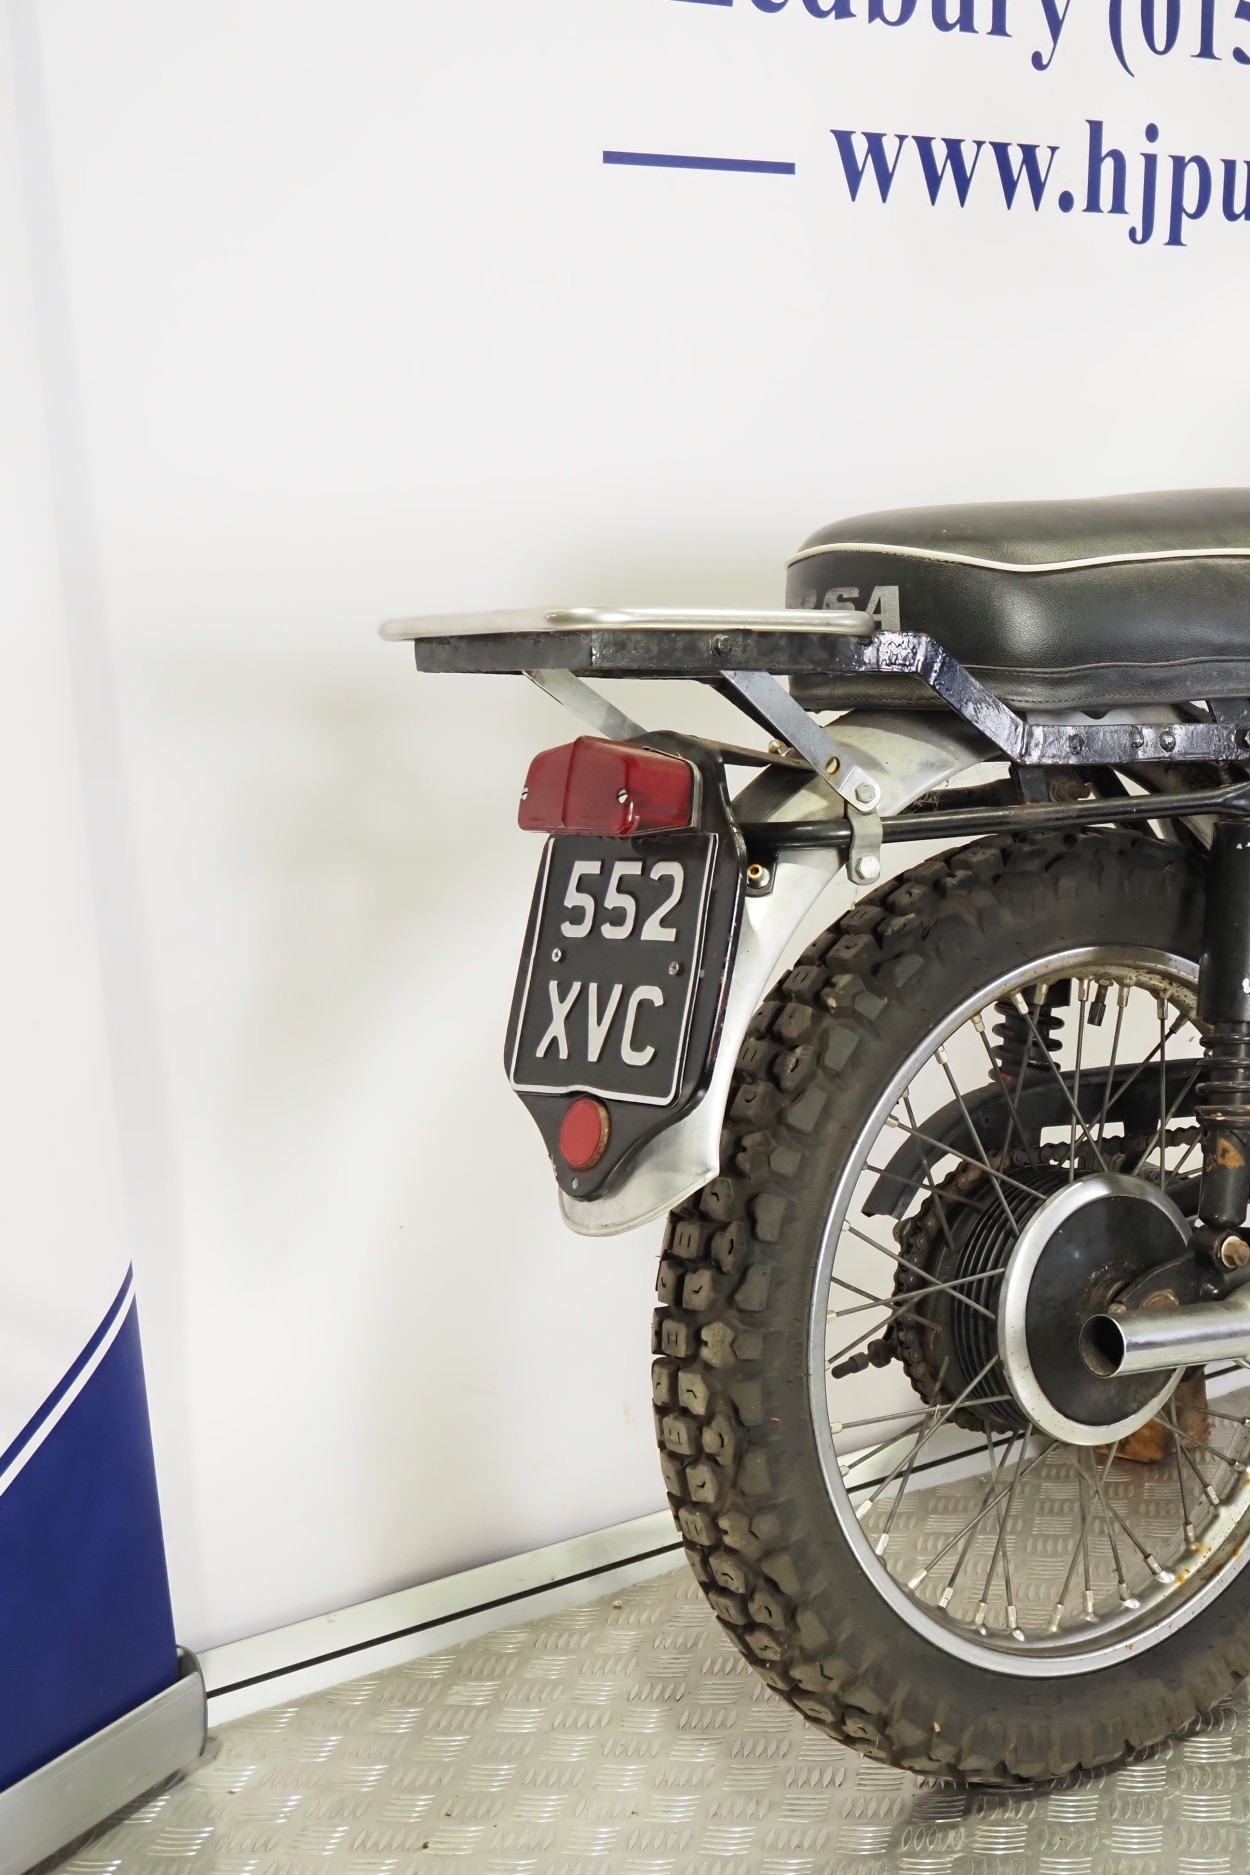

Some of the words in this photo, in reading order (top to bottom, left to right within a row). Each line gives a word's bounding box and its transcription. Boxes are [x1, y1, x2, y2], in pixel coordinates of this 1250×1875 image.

[799, 585, 901, 631] SA
[560, 860, 686, 943] 552
[535, 980, 665, 1067] XVC
